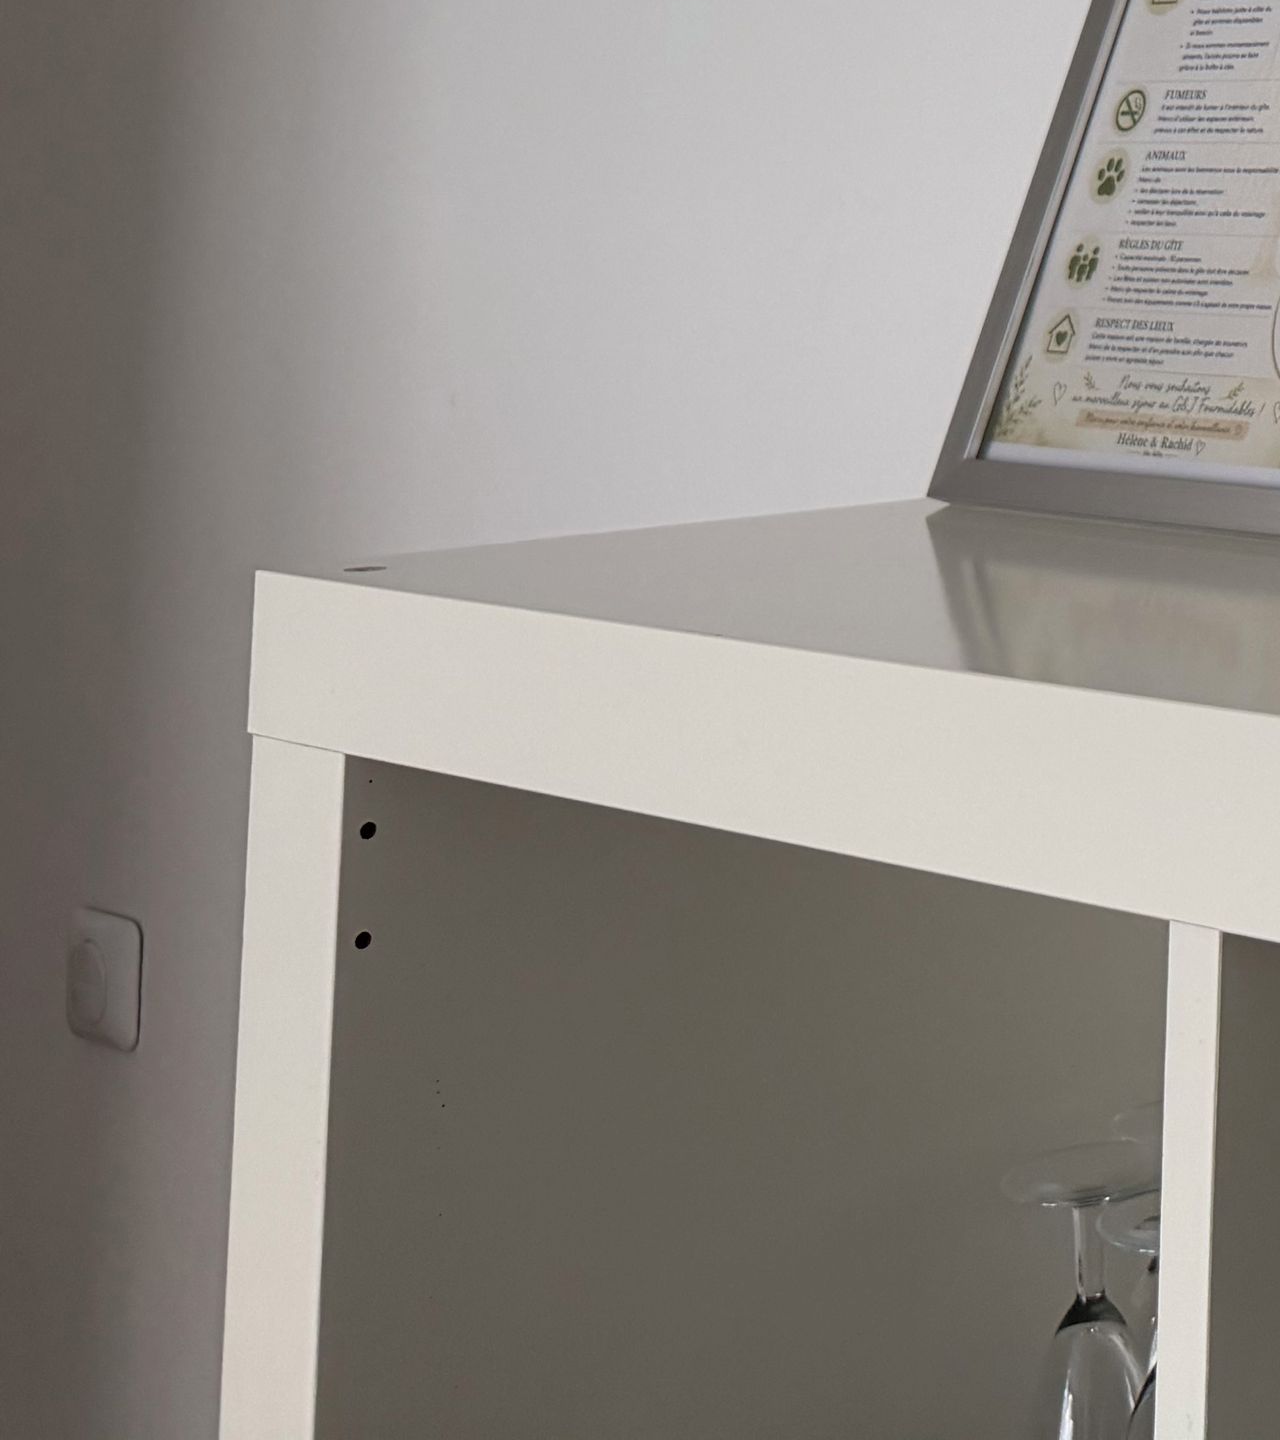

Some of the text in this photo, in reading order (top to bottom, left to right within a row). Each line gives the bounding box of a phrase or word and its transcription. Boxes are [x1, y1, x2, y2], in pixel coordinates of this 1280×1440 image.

[1164, 89, 1207, 100] FUMEURS
[1145, 150, 1186, 161] ANIMAUX
[1118, 238, 1183, 251] RÈGLES DU GÎTE
[1094, 317, 1174, 332] RESPECT DES LIEUX
[1116, 432, 1193, 451] Hélène & Rachid
